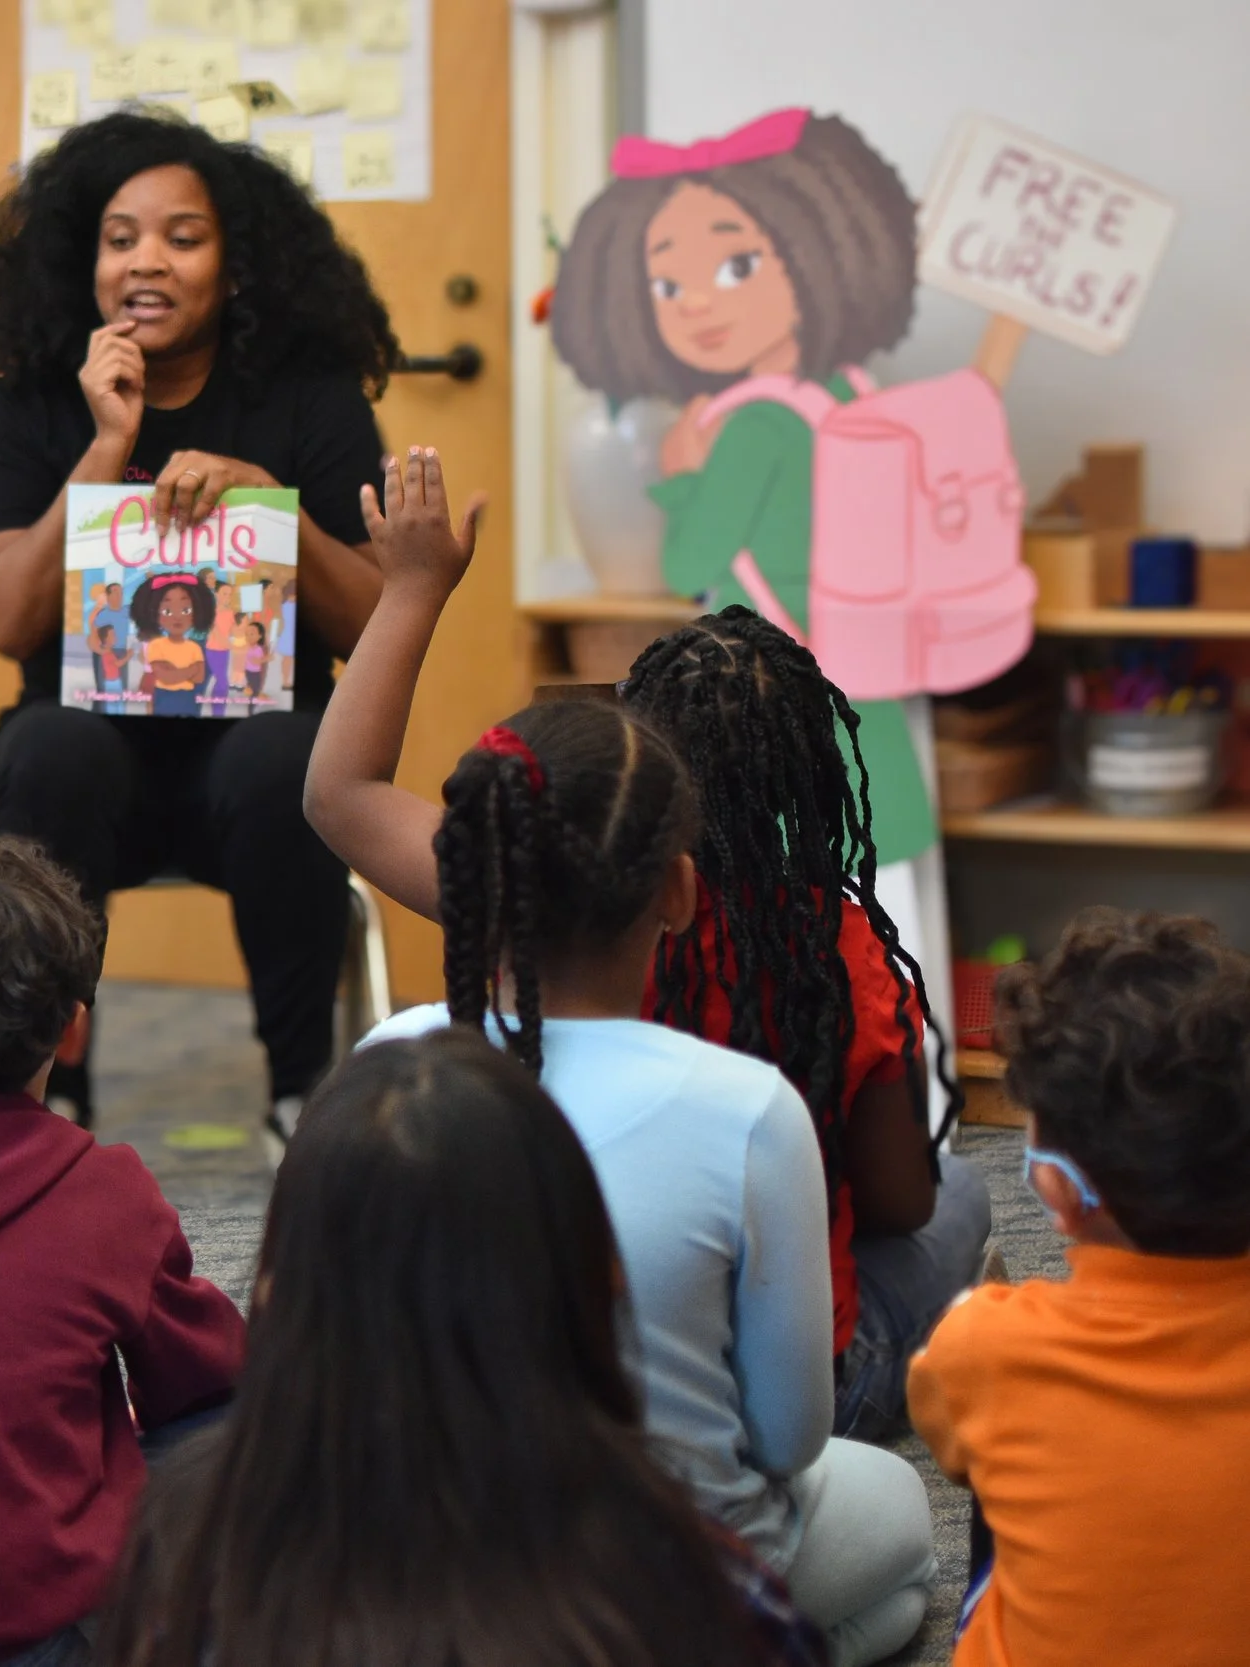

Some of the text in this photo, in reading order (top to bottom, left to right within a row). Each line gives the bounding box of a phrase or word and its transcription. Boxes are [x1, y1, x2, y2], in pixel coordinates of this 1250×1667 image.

[979, 147, 1136, 247] FREE
[948, 220, 1138, 327] CURLS!
[109, 495, 259, 569] Curls
